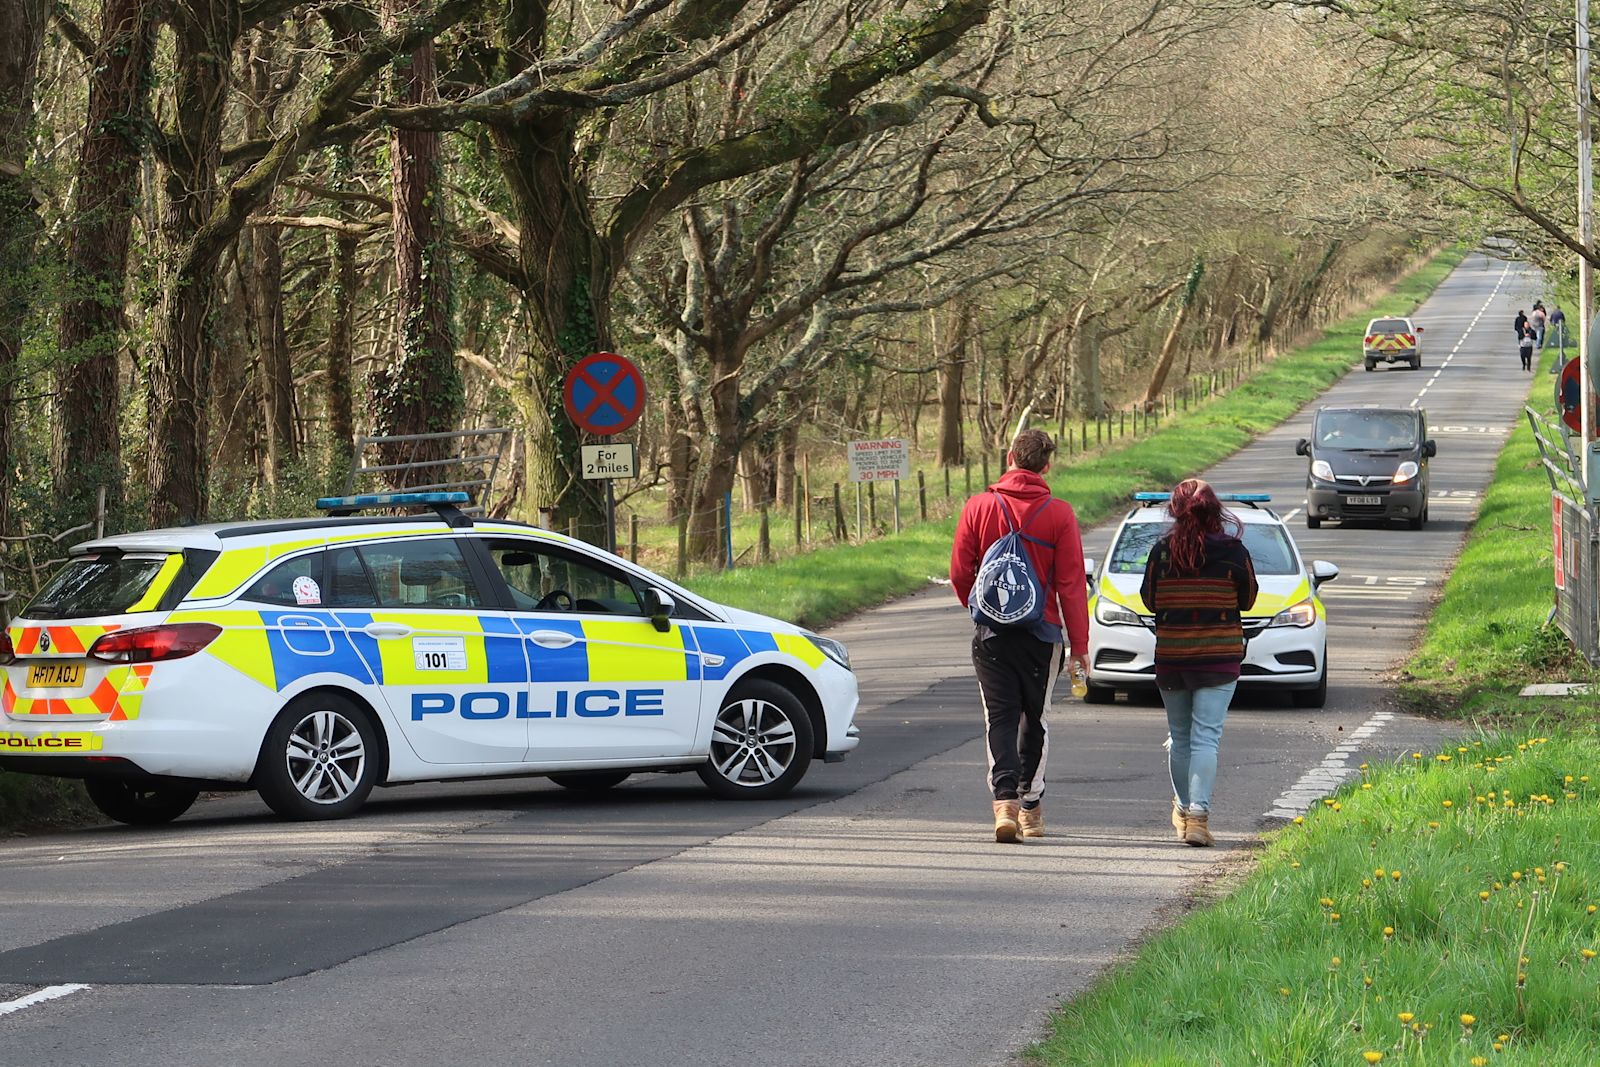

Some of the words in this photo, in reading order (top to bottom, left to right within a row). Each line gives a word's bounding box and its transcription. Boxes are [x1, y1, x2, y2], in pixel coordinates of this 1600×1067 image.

[854, 440, 902, 450] WARNING
[598, 450, 617, 460] For
[587, 464, 594, 474] 2
[597, 463, 629, 473] miles
[860, 471, 874, 480] 30
[877, 470, 899, 479] MPH
[989, 580, 1026, 592] SKECHERS
[425, 653, 447, 668] 101
[32, 665, 55, 683] HF17
[56, 665, 79, 683] AOJ
[411, 689, 665, 721] POLICE
